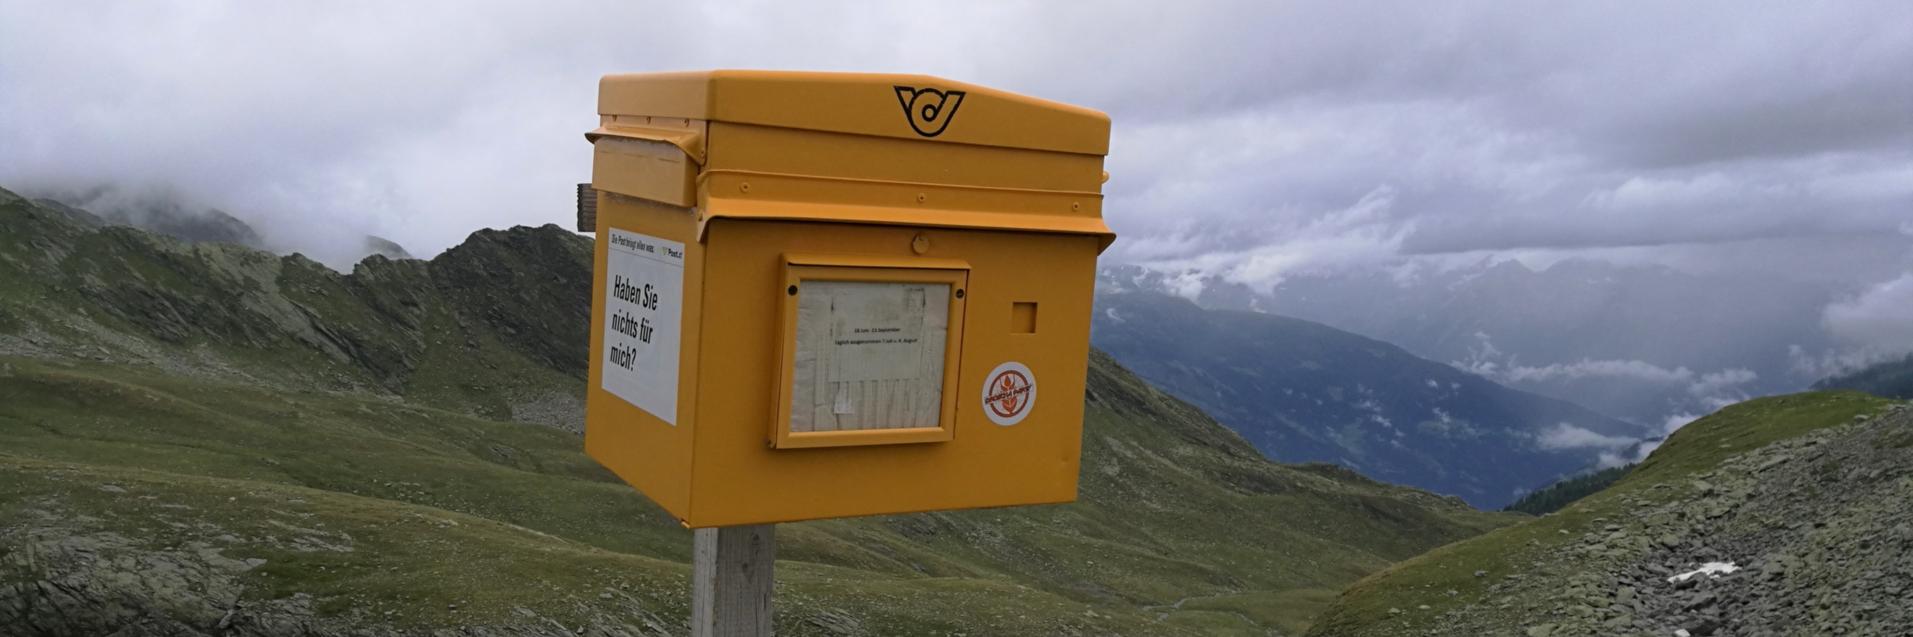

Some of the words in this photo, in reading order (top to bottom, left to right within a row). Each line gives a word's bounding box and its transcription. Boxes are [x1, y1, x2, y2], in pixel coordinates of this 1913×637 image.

[613, 274, 641, 305] Haben
[642, 283, 658, 311] Sie
[612, 308, 638, 339] nichts
[639, 317, 654, 345] für
[610, 342, 636, 371] mich?
